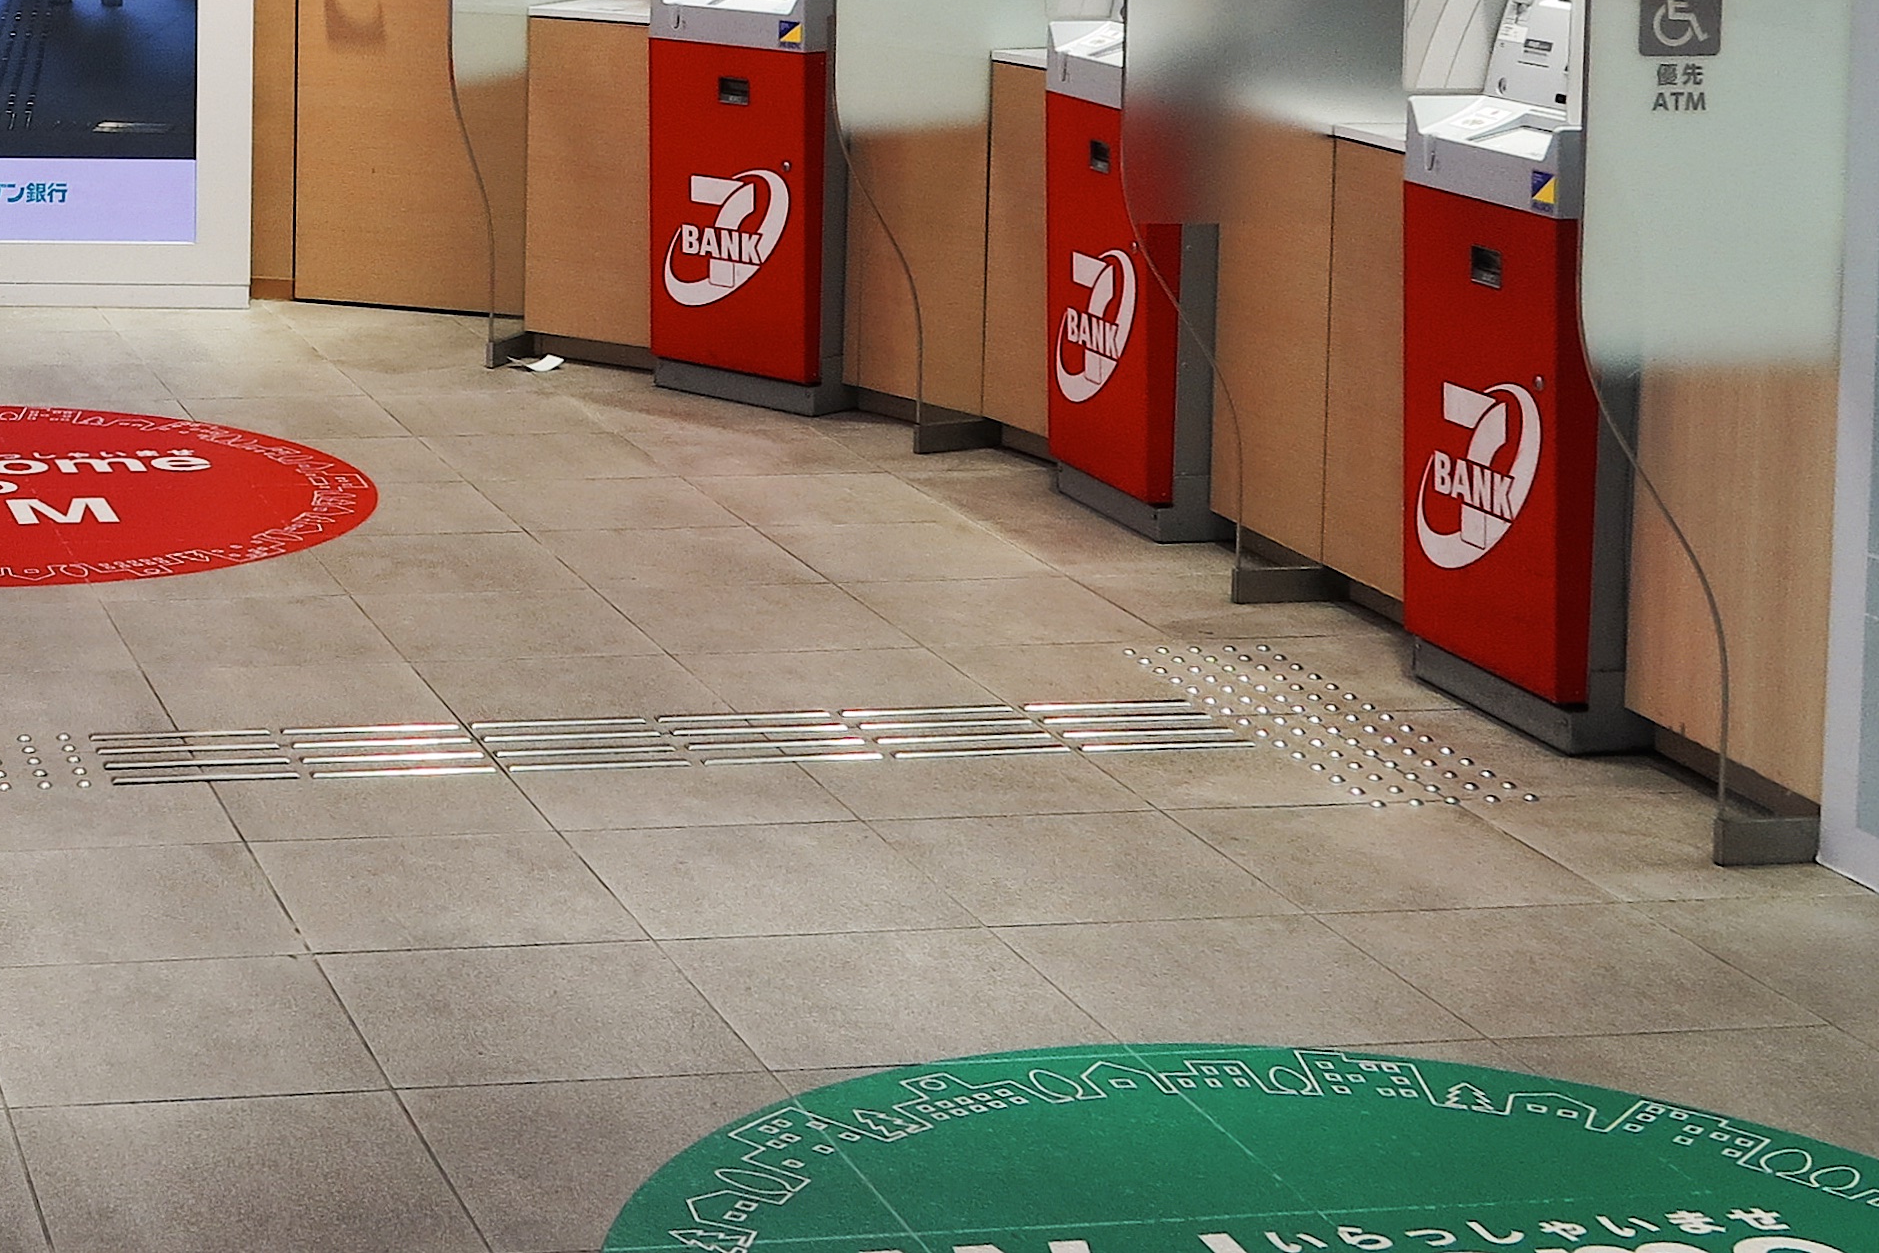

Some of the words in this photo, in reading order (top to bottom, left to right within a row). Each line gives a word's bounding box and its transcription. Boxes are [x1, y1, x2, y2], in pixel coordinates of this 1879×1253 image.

[1657, 63, 1705, 86] 優先
[1652, 92, 1707, 111] ATM
[681, 222, 762, 266] BANK
[1067, 306, 1120, 361] BANK
[1432, 449, 1516, 522] BANK
[1264, 1206, 1793, 1253] いらっしゃいませ
